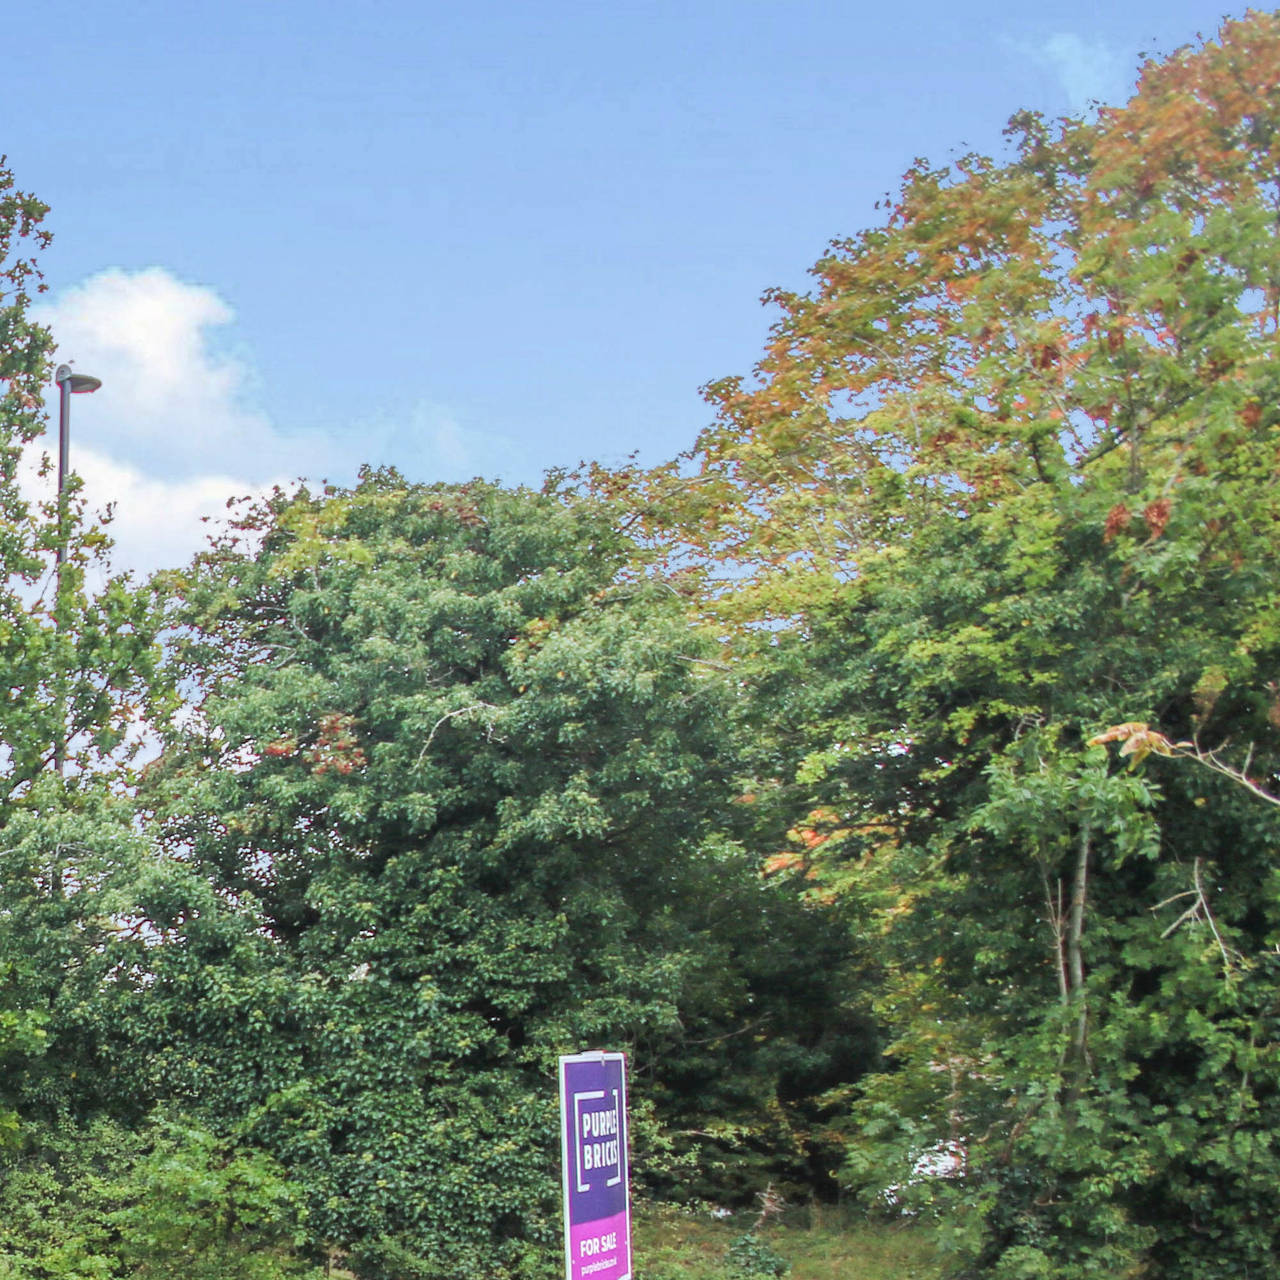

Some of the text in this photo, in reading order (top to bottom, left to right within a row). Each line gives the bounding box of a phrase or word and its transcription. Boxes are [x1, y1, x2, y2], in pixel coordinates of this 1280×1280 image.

[582, 1110, 616, 1138] PURPLE
[583, 1140, 617, 1170] BRICKS
[580, 1232, 617, 1258] FOR SALE
